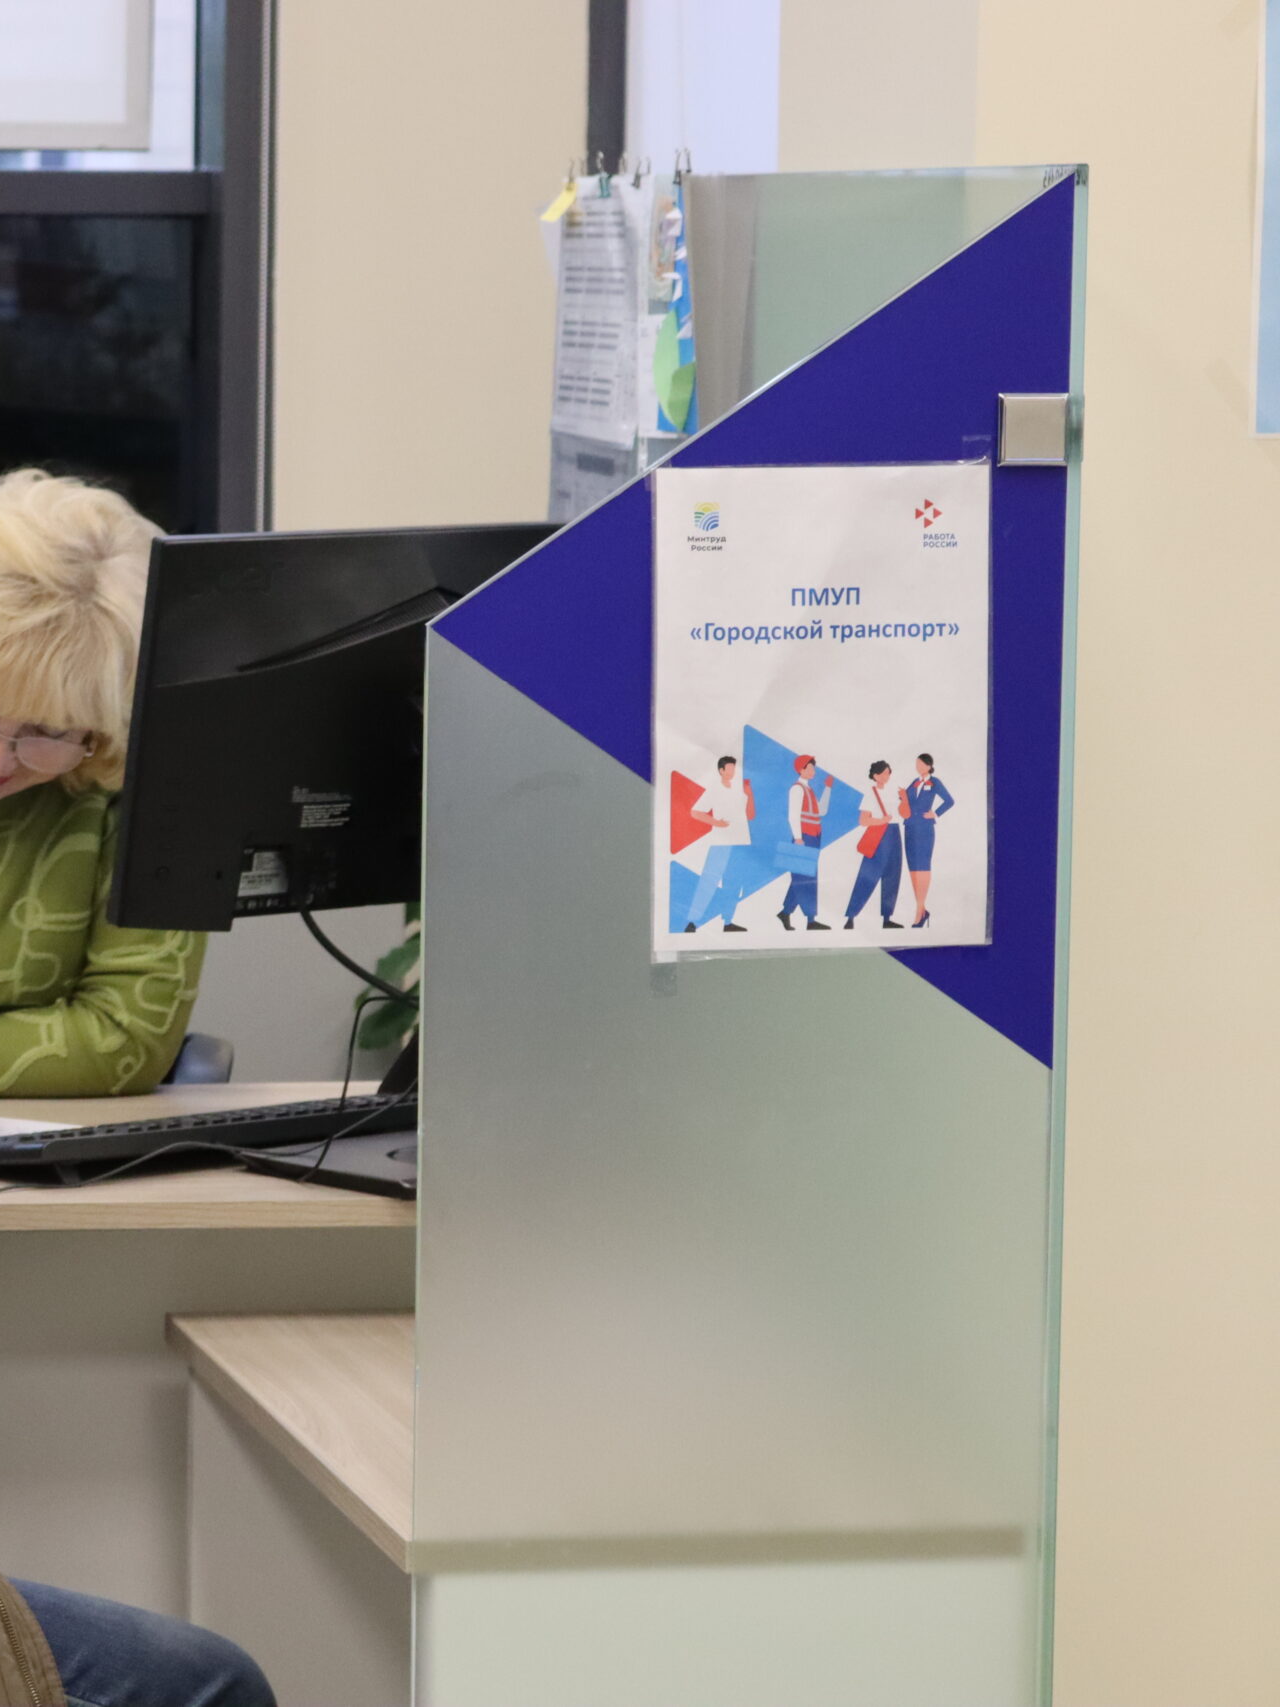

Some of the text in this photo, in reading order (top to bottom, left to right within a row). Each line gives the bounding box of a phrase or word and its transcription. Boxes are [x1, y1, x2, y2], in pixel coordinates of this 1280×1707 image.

[923, 533, 956, 541] РАБОТА
[690, 544, 723, 552] России
[790, 587, 861, 606] ПМУП
[690, 619, 960, 645] «Городской транспорт»
